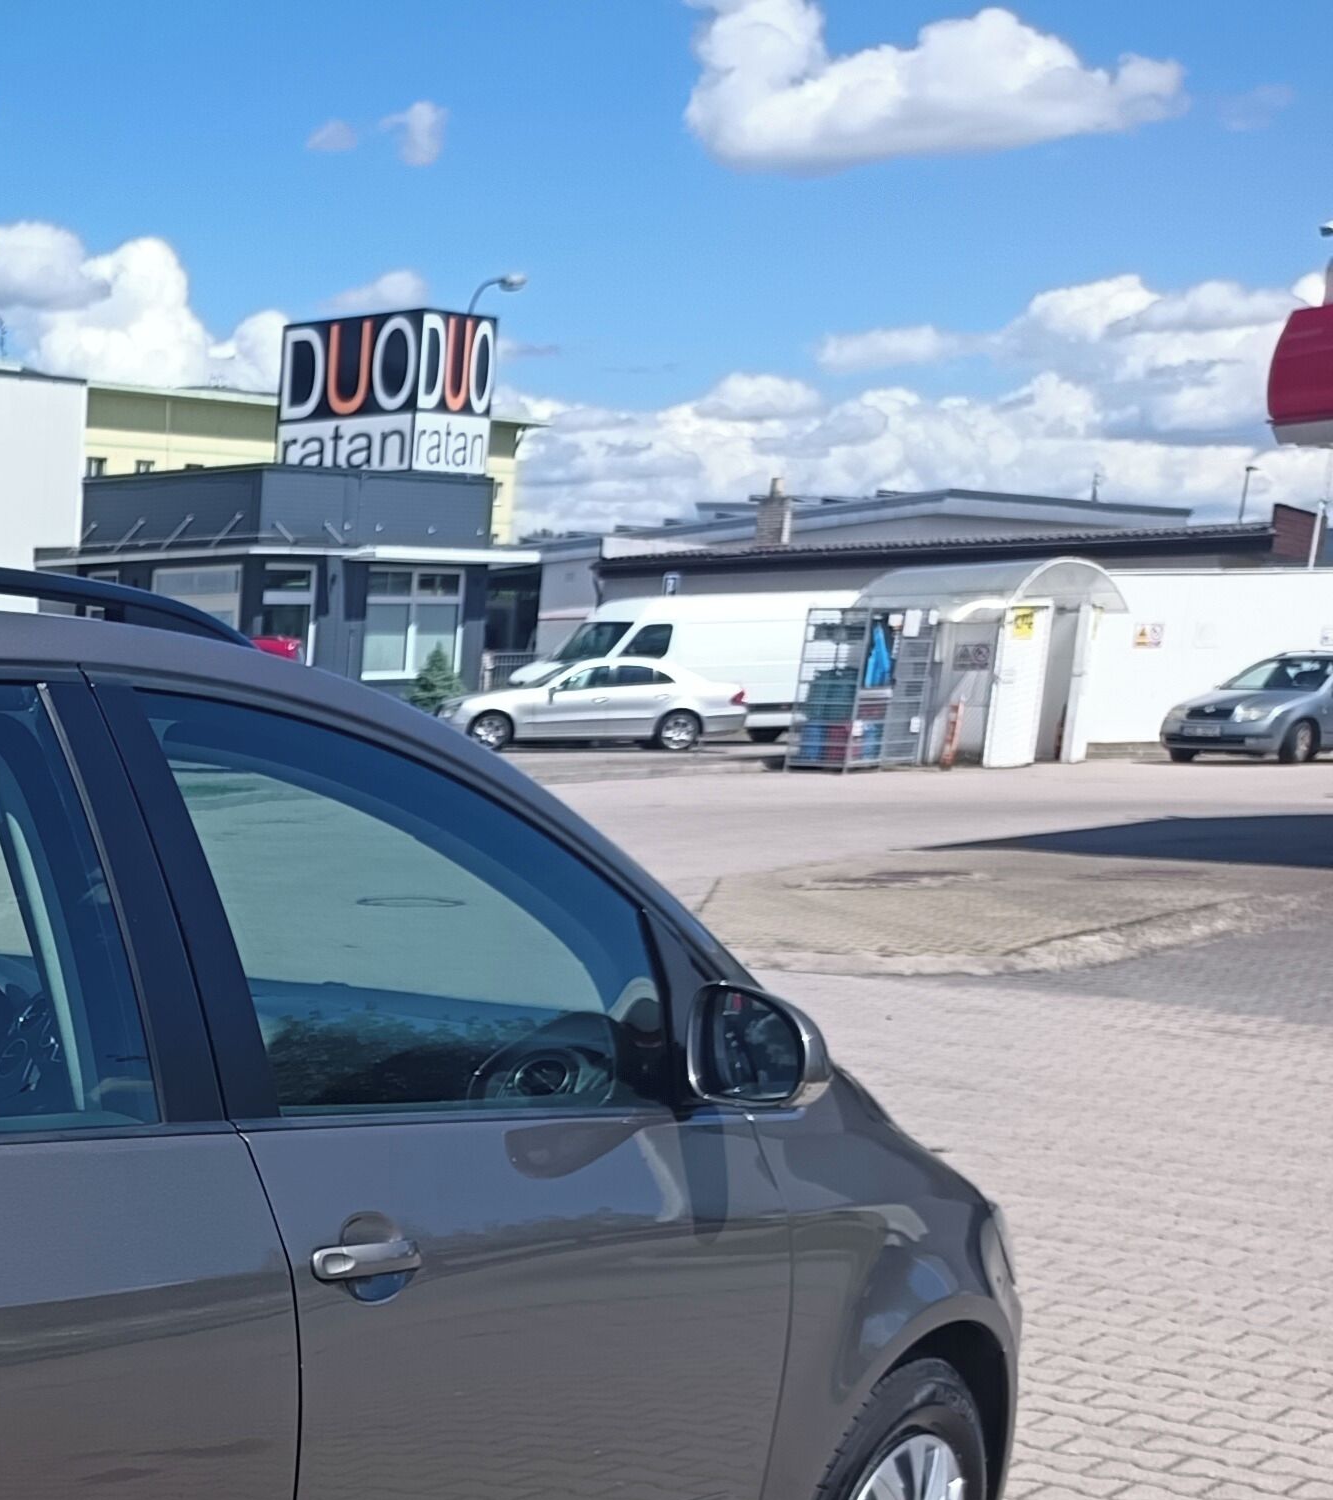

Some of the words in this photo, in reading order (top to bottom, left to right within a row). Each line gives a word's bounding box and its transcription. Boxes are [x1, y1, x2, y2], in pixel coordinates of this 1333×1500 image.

[280, 316, 417, 421] DUO
[417, 313, 494, 415] DUO
[282, 424, 405, 468] ratan
[415, 422, 483, 467] ratan
